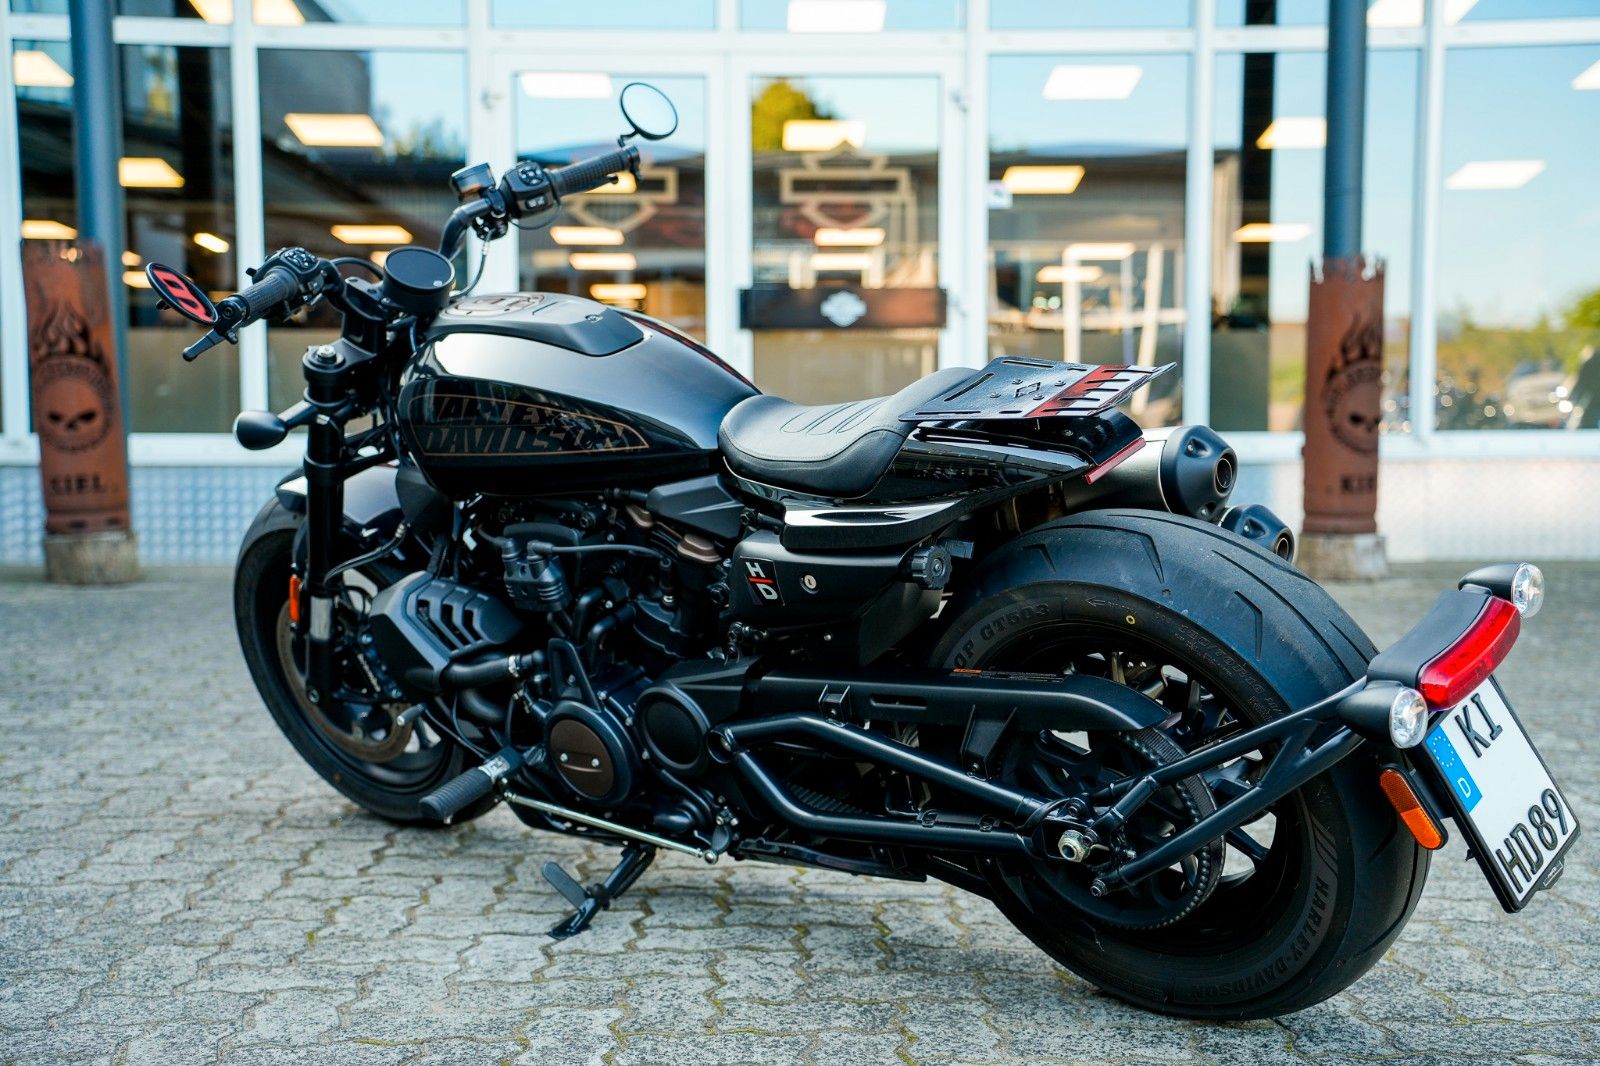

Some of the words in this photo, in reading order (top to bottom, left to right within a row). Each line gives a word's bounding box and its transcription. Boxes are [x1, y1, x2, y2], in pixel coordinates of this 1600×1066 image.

[981, 603, 1049, 640] GT503
[1454, 692, 1503, 758] KI
[1457, 777, 1471, 798] D
